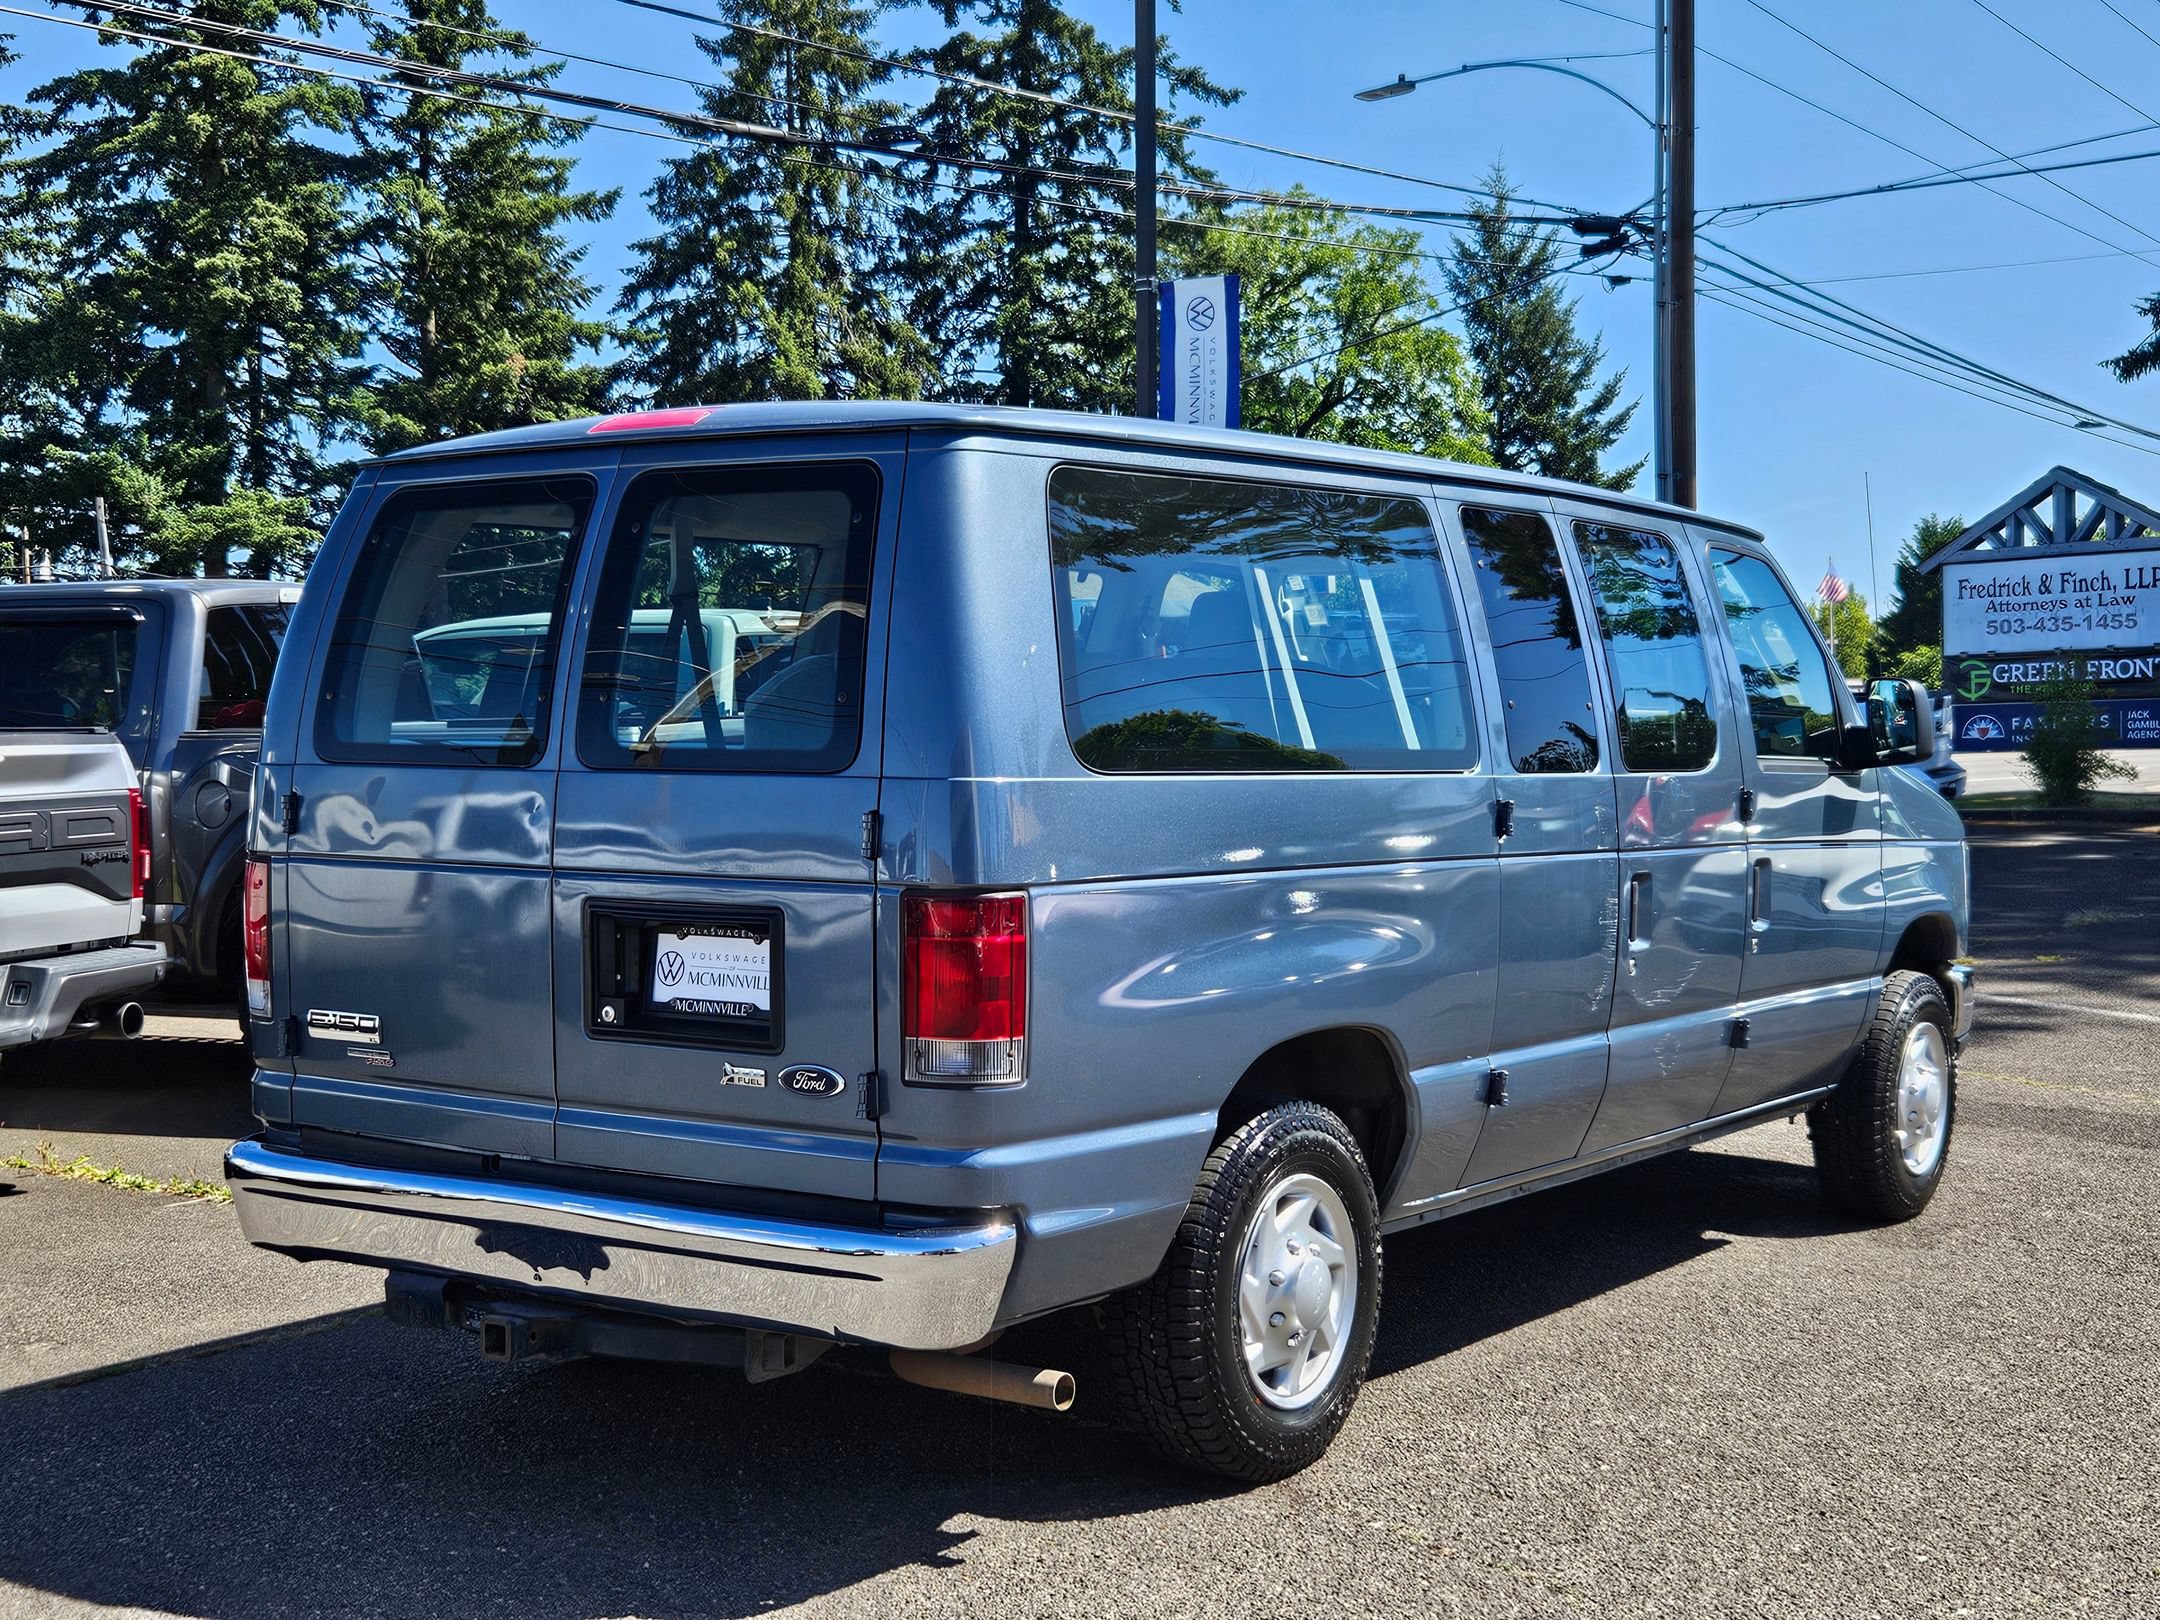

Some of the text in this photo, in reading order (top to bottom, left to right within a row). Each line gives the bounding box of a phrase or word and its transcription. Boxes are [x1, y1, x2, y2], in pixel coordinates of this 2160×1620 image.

[1957, 565, 2160, 600] Fredrick & Finch, LLP
[1985, 593, 2136, 614] Attorneys at Law
[1986, 612, 2138, 636] 503-435-1455
[2010, 684, 2031, 694] THE
[2128, 710, 2150, 719] JACK
[674, 999, 748, 1017] MCMINNVILLE
[737, 1076, 762, 1086] FUEL
[792, 1070, 826, 1091] Ford
